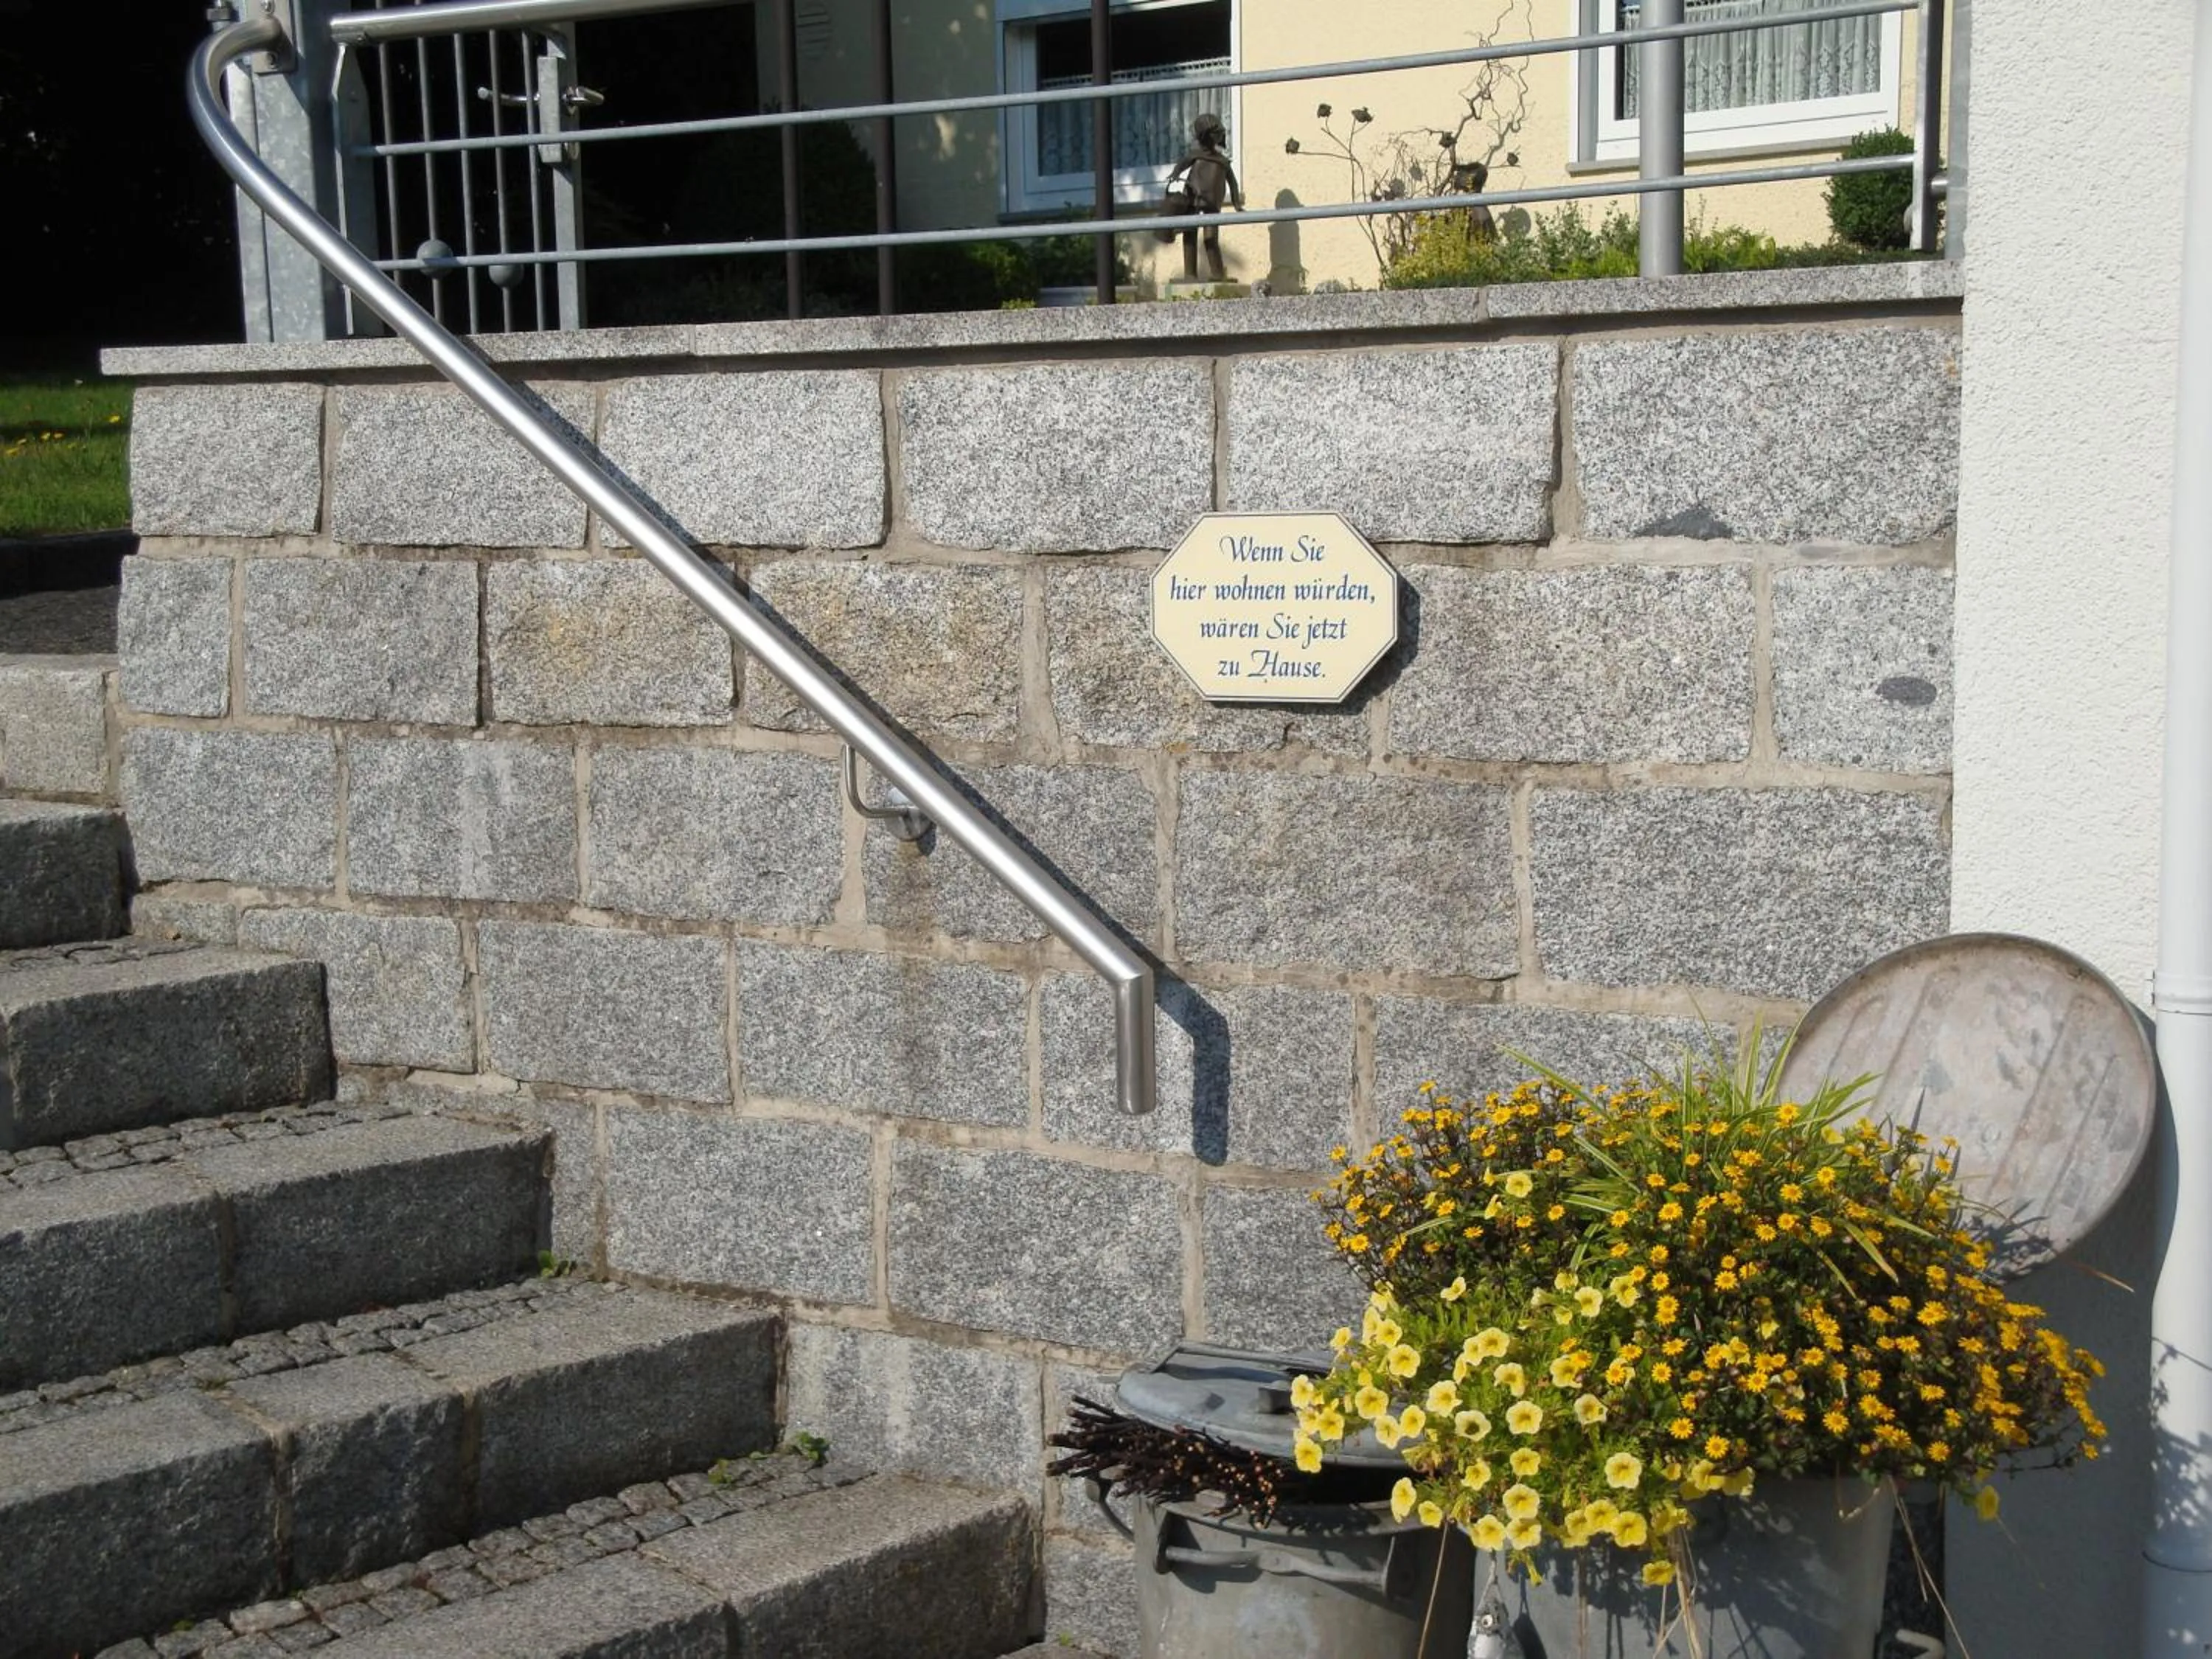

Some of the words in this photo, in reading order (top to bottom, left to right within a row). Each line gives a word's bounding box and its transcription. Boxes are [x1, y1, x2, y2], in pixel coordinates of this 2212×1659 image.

[1219, 535, 1284, 563] Wenn
[1290, 535, 1326, 563] Sie
[1169, 574, 1208, 601] hier
[1214, 574, 1286, 600] wohnen
[1294, 573, 1377, 605] würden,
[1200, 617, 1259, 639] wären
[1266, 613, 1301, 640] Sie
[1301, 615, 1349, 650] jetzt
[1217, 659, 1240, 678] zu
[1247, 649, 1326, 678] Hause.
